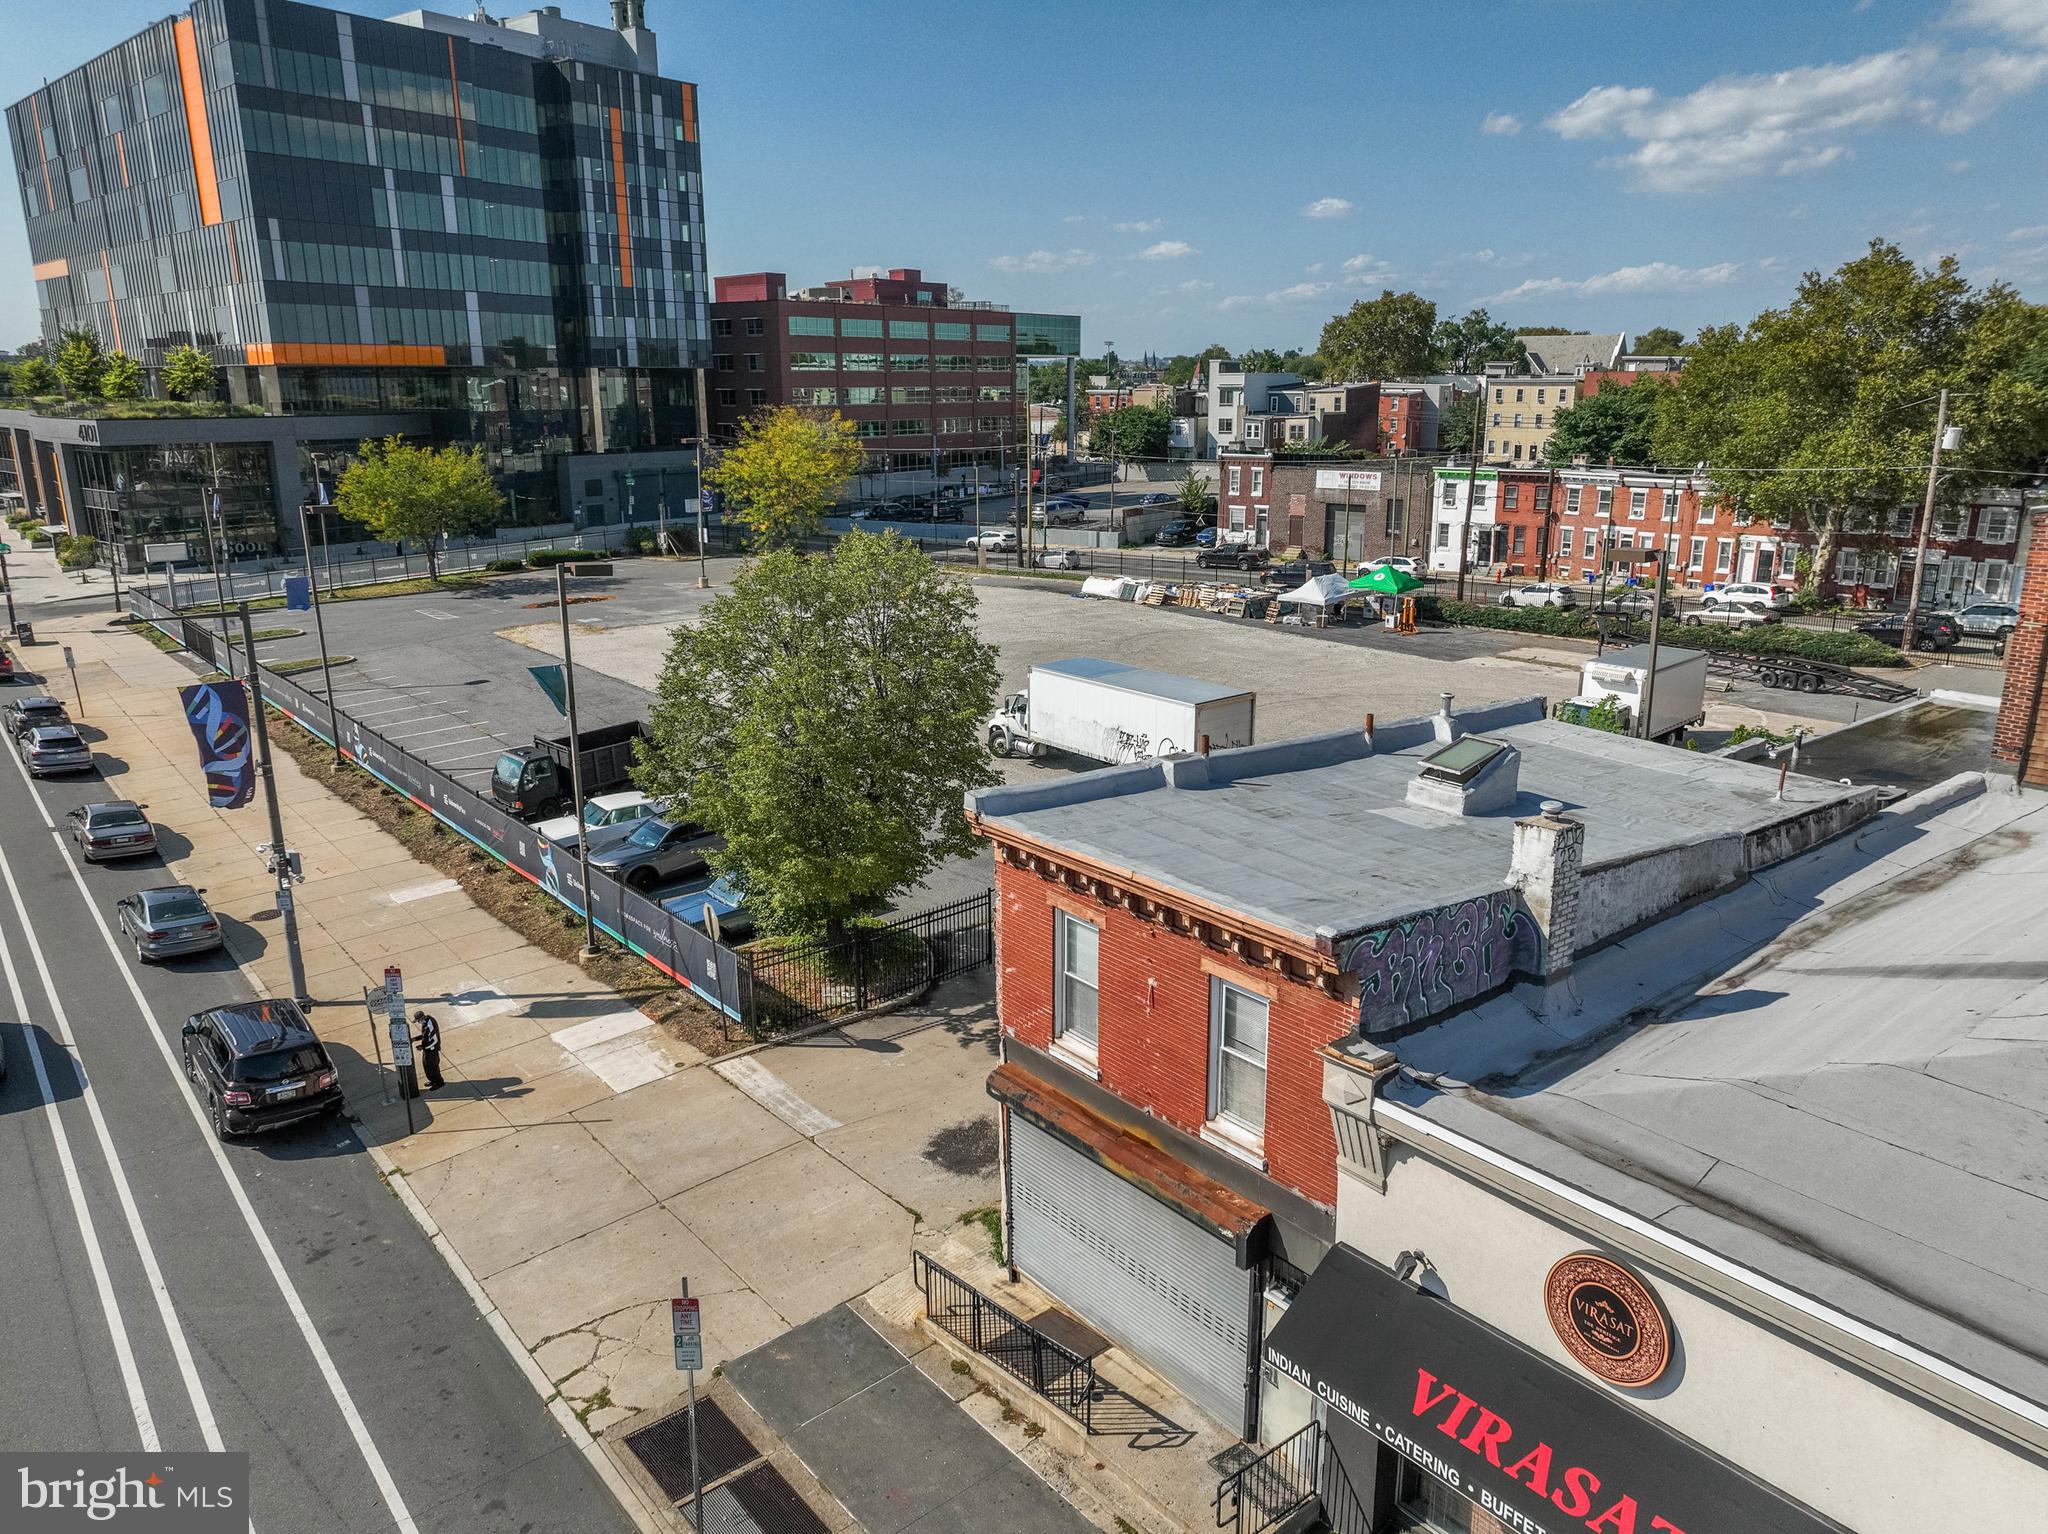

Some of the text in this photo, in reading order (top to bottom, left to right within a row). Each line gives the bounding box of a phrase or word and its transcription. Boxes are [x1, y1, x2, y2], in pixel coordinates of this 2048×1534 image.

[1339, 472, 1377, 480] WINDOWS
[1576, 1297, 1634, 1337] VIRASAT
[676, 1337, 682, 1347] 2
[1268, 1346, 1311, 1387] INDIAN
[1317, 1380, 1370, 1427] CUISINE
[1385, 1426, 1460, 1486] CATERING
